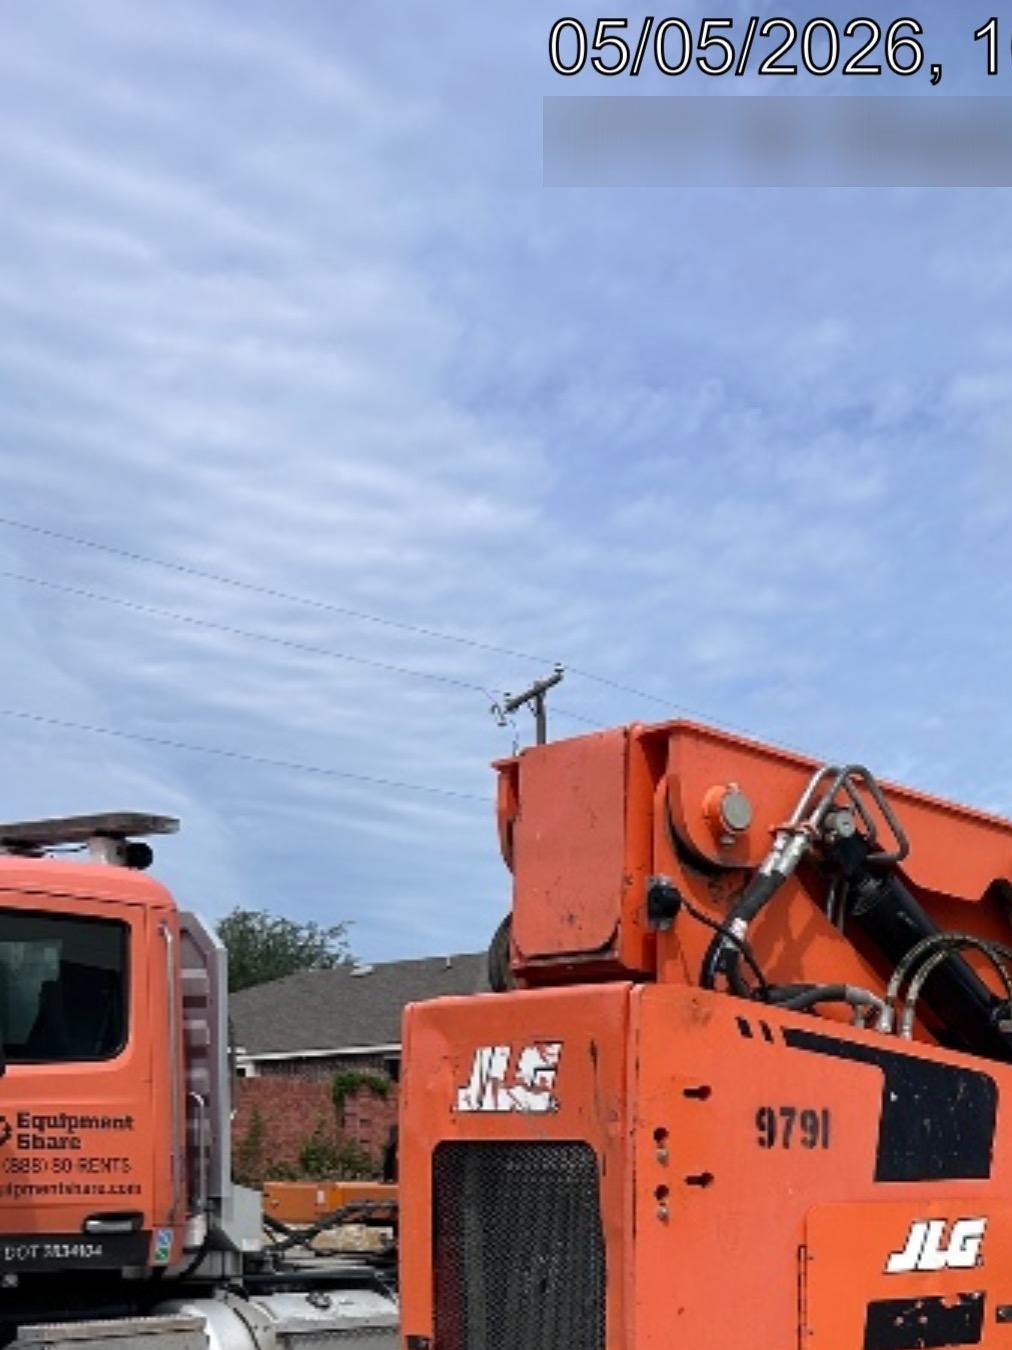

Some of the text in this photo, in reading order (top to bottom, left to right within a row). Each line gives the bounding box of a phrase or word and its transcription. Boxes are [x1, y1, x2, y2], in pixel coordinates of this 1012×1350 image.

[16, 1111, 135, 1134] Equipment
[754, 1106, 831, 1150] 9791
[16, 1133, 82, 1150] Share
[882, 1216, 988, 1274] JLG
